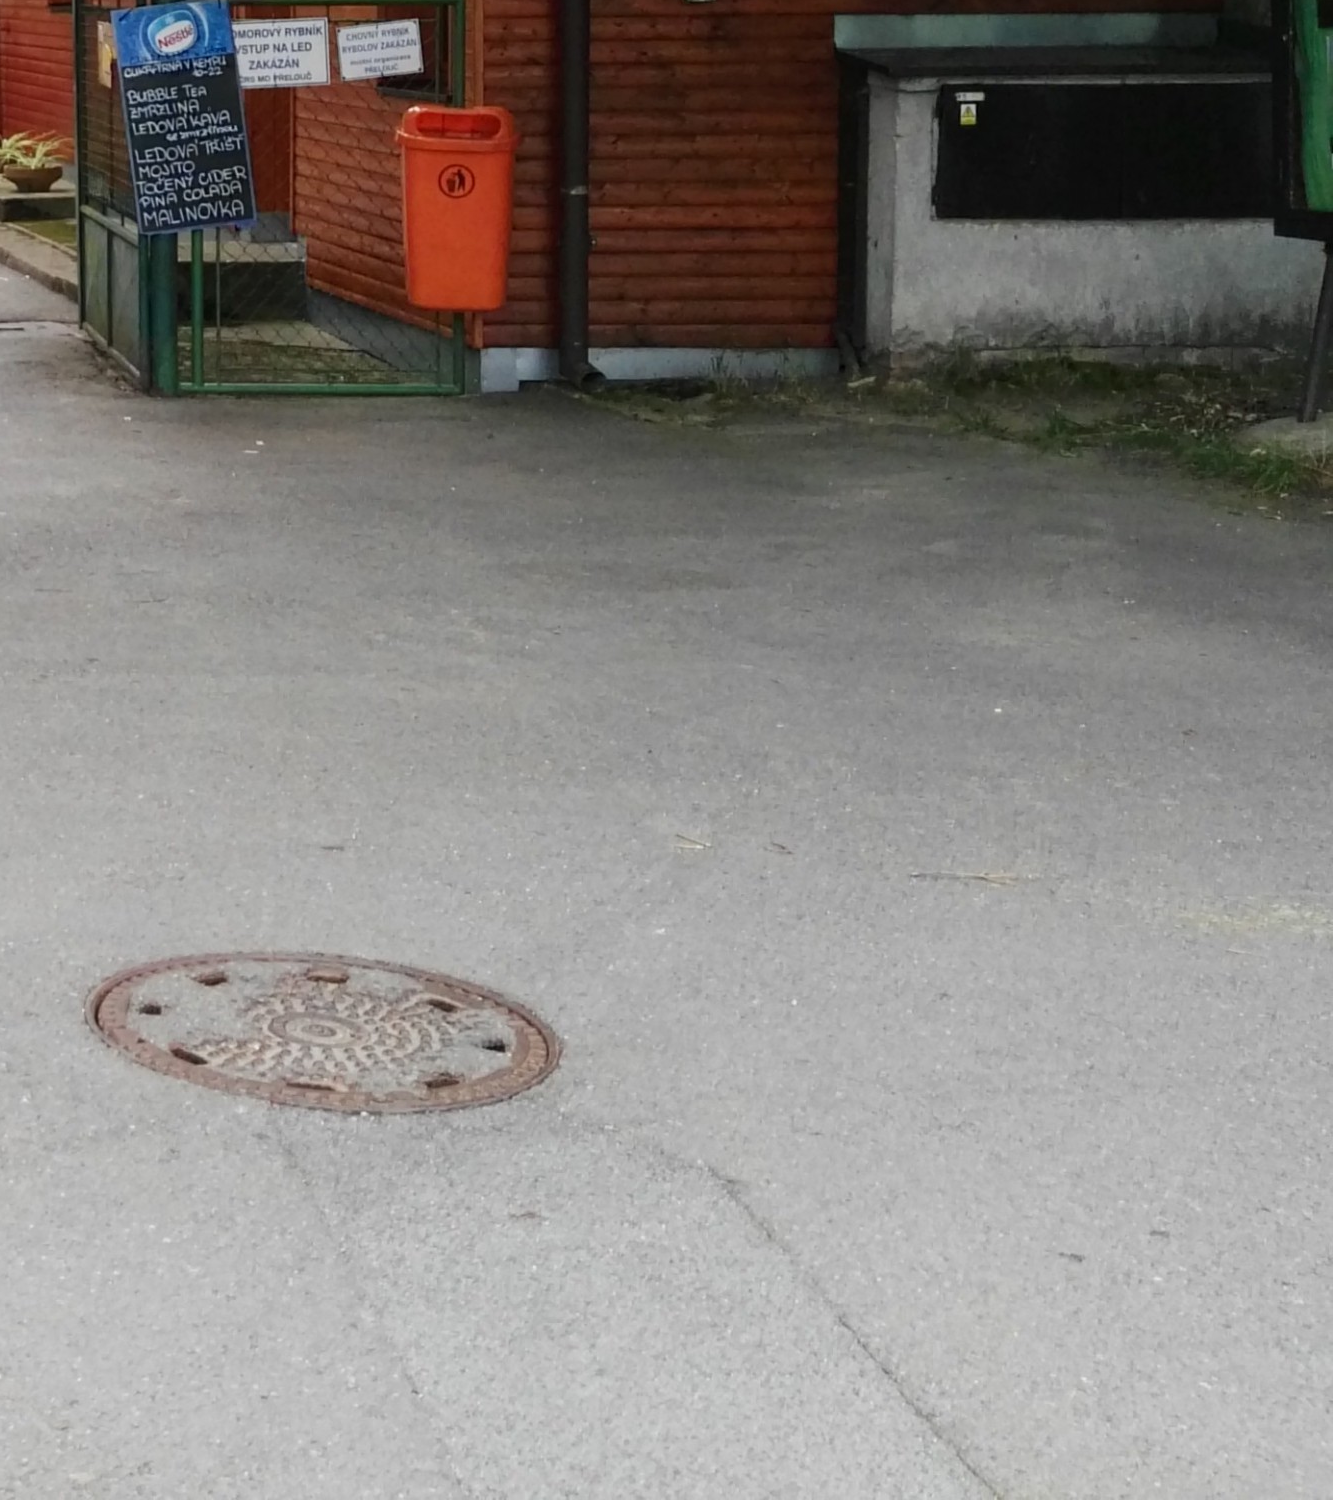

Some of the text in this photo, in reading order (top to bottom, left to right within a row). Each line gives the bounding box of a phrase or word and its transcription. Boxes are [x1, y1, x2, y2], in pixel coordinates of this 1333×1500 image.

[232, 24, 323, 39] OMOROVÝ RYBNÍK
[272, 43, 288, 53] NA
[291, 41, 313, 52] LED
[248, 57, 300, 71] ZAKÁZÁN
[127, 84, 207, 104] BUBBLE TEA
[129, 99, 200, 118] ZMRZLINA
[138, 161, 195, 179] MOJITO
[136, 166, 247, 195] TOČENÝ CIDER
[183, 181, 242, 201] COLADA
[143, 200, 245, 227] MALINOVKA
